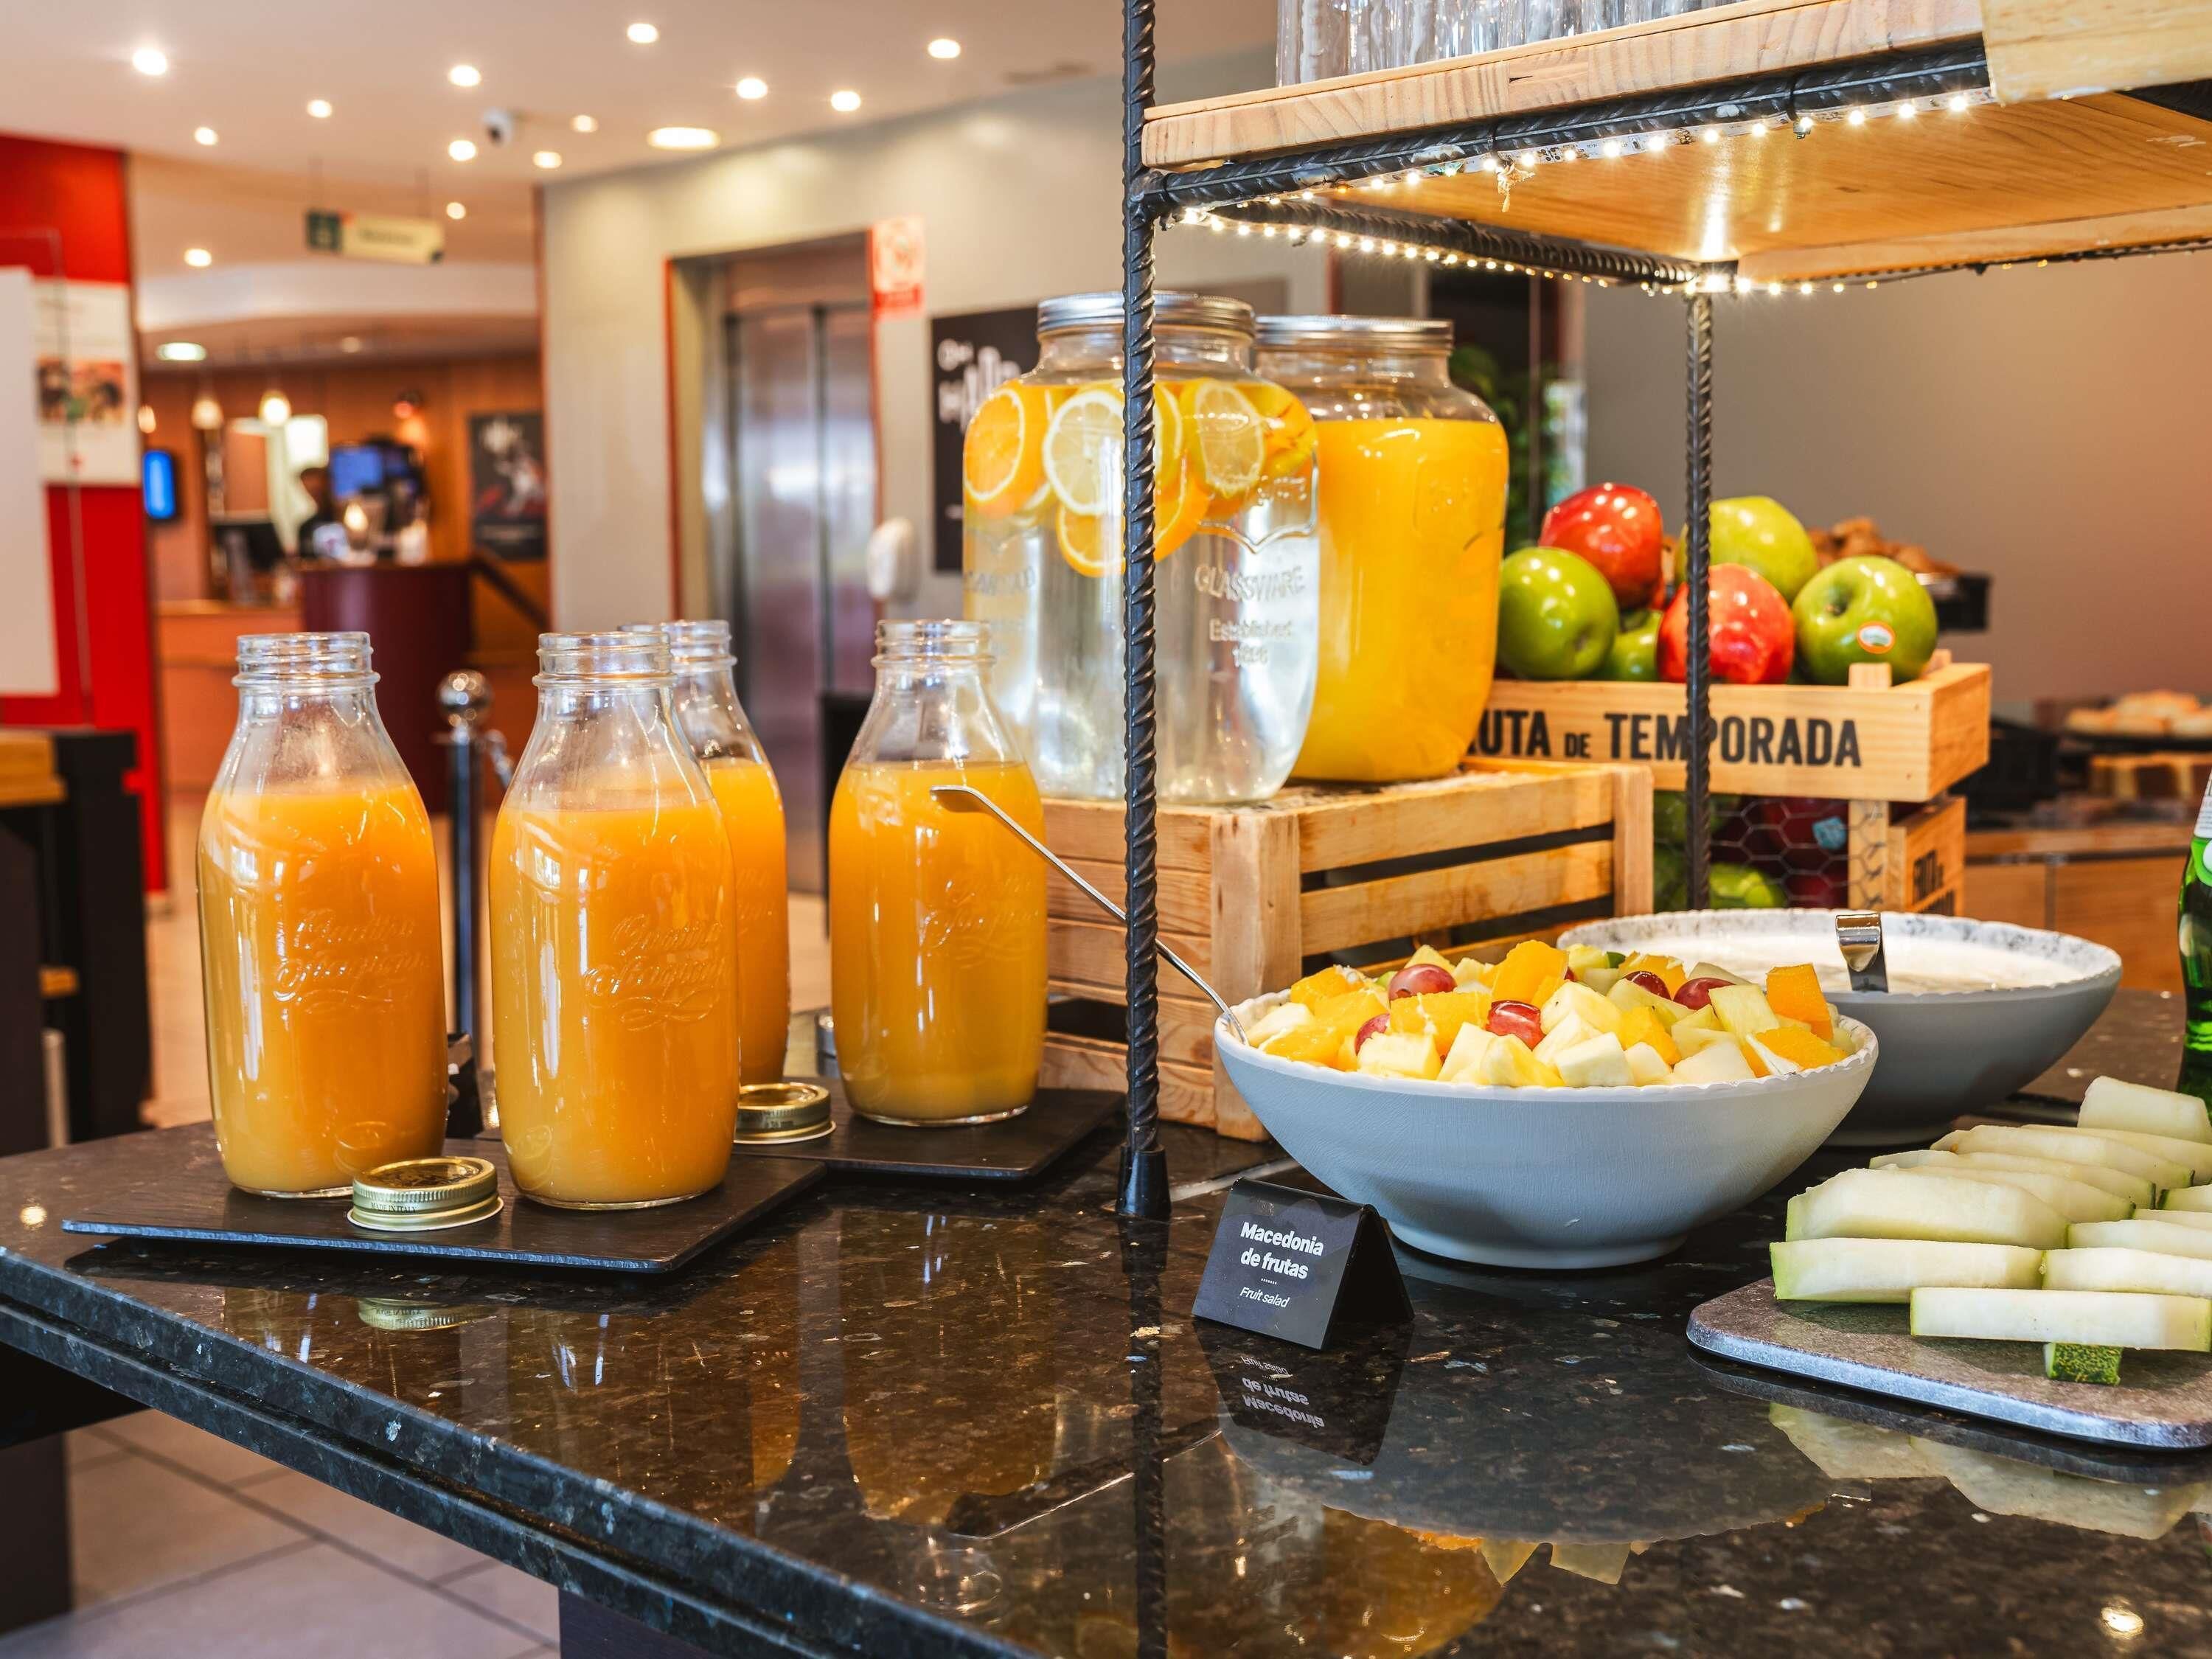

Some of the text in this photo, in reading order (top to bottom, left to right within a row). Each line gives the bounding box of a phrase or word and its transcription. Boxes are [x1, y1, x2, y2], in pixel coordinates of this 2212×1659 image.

[1467, 710, 1551, 757] UTA
[1565, 732, 1591, 759] DE
[397, 1206, 417, 1214] ITALY
[1240, 1221, 1324, 1256] Macedonia
[1240, 1248, 1309, 1279] de frutas
[1239, 1287, 1290, 1308] Fruit salad
